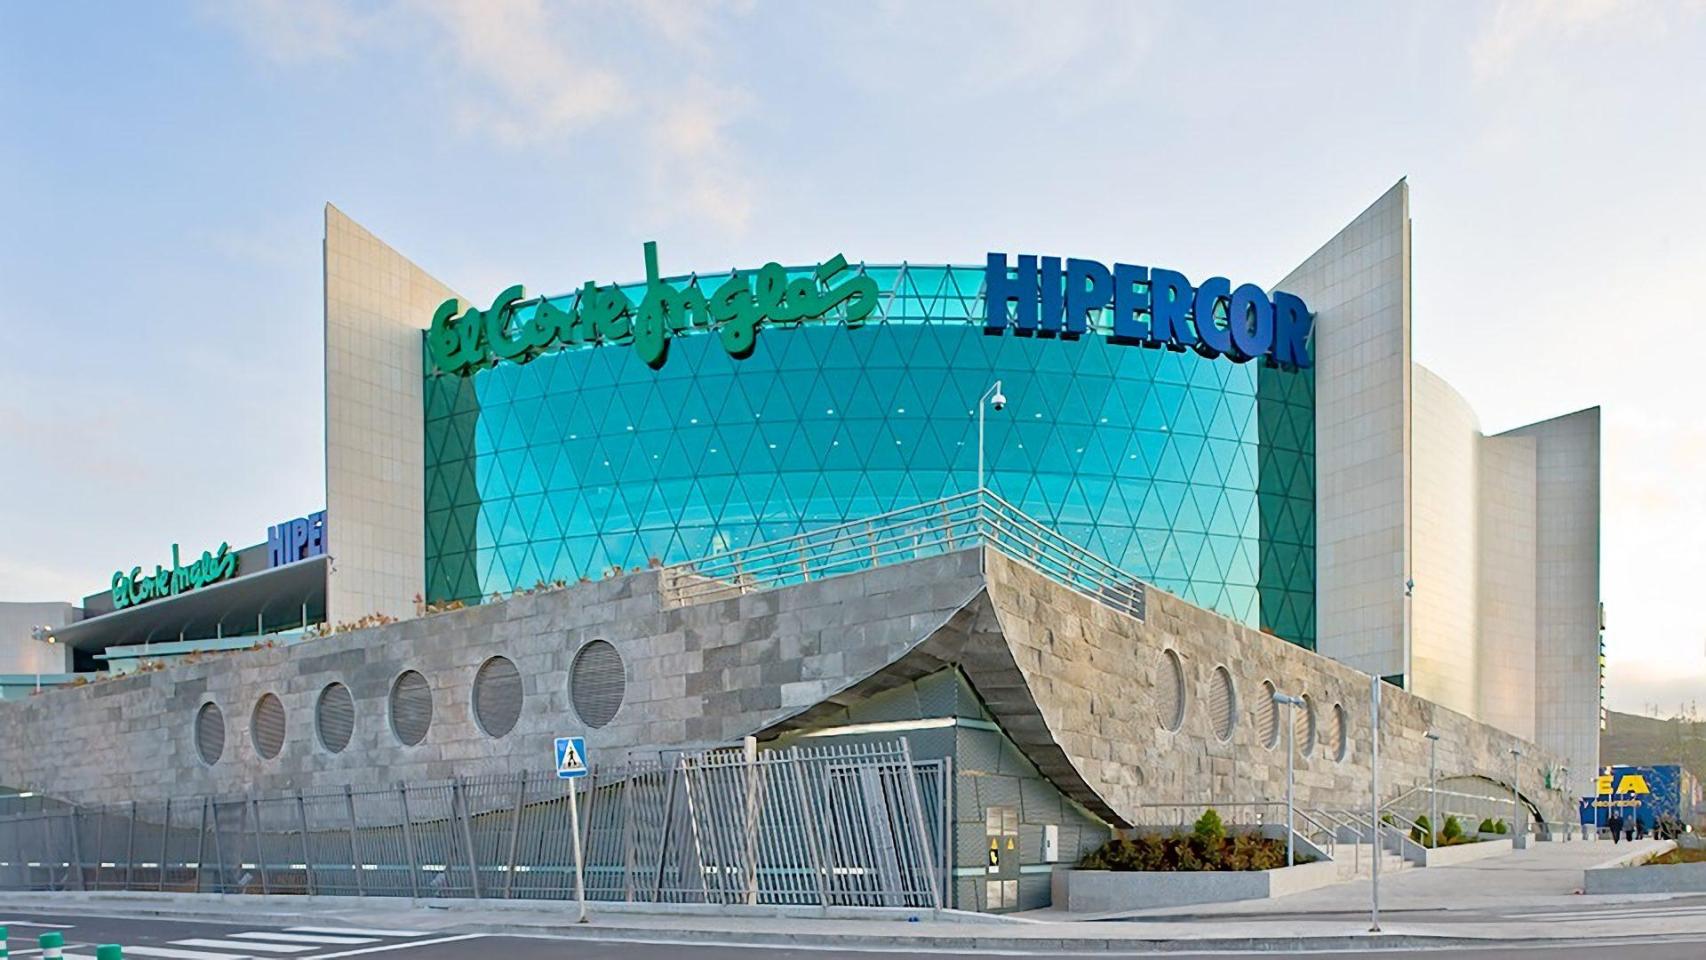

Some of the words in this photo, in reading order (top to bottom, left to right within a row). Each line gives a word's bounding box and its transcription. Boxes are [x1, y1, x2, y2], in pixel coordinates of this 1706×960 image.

[430, 298, 485, 374] El
[486, 281, 637, 360] Corte
[633, 241, 879, 369] Inglés
[985, 252, 1314, 370] HIPERCOR
[112, 570, 129, 609] El
[129, 565, 169, 605] Corte
[1597, 775, 1650, 795] EA
